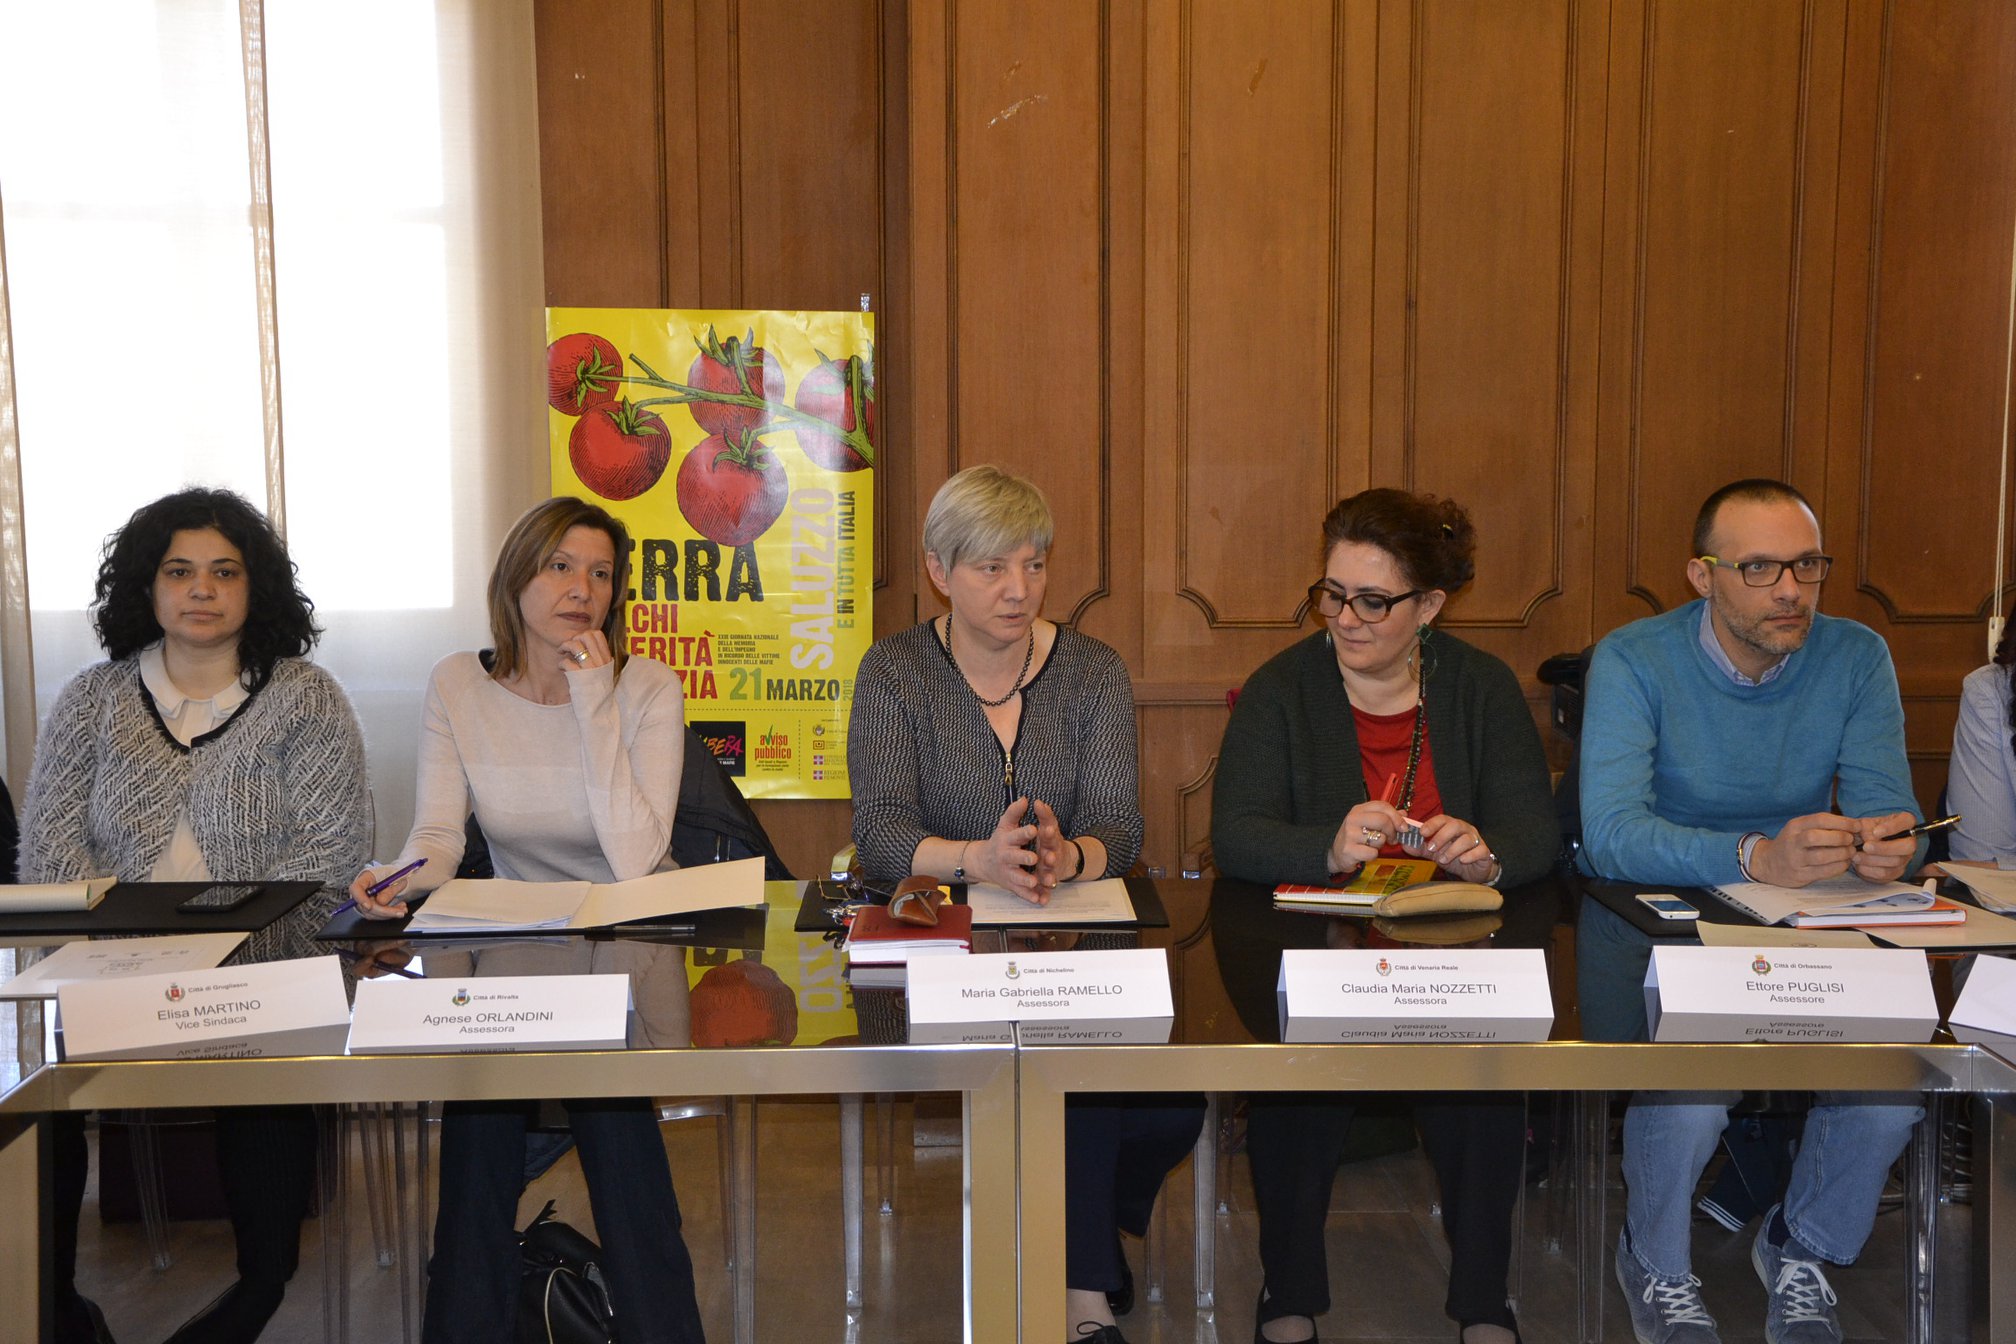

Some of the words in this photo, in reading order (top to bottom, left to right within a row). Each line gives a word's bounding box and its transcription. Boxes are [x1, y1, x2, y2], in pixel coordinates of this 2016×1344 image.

[838, 491, 855, 540] ITALIA
[837, 546, 855, 595] TUTTA
[790, 488, 835, 670] SALUZZO
[837, 599, 854, 614] IN
[627, 604, 678, 633] CHI
[837, 619, 854, 628] E
[730, 667, 762, 700] 21
[766, 679, 840, 701] MARZO
[843, 679, 853, 701] 2018
[754, 745, 791, 761] pubblico
[213, 982, 249, 992] Grugliasco
[961, 988, 996, 998] Maria
[999, 986, 1054, 997] Gabriella
[1058, 984, 1123, 996] RAMELLO
[1341, 983, 1388, 994] Claudia
[1392, 983, 1426, 994] Maria
[1430, 983, 1497, 994] NOZZETTI
[1746, 981, 1785, 992] Ettore
[1787, 982, 1845, 993] PUGLISI
[1017, 999, 1070, 1008] Assessora
[1394, 996, 1447, 1005] Assessora
[1769, 994, 1825, 1004] Assessore
[157, 1008, 190, 1021] Elisa
[193, 1000, 261, 1017] MARTINO
[176, 1019, 200, 1031] Vice
[203, 1015, 247, 1027] Sindaca
[423, 1014, 472, 1026] Agnese
[476, 1011, 553, 1023] ORLANDINI
[459, 1025, 515, 1034] Assessora
